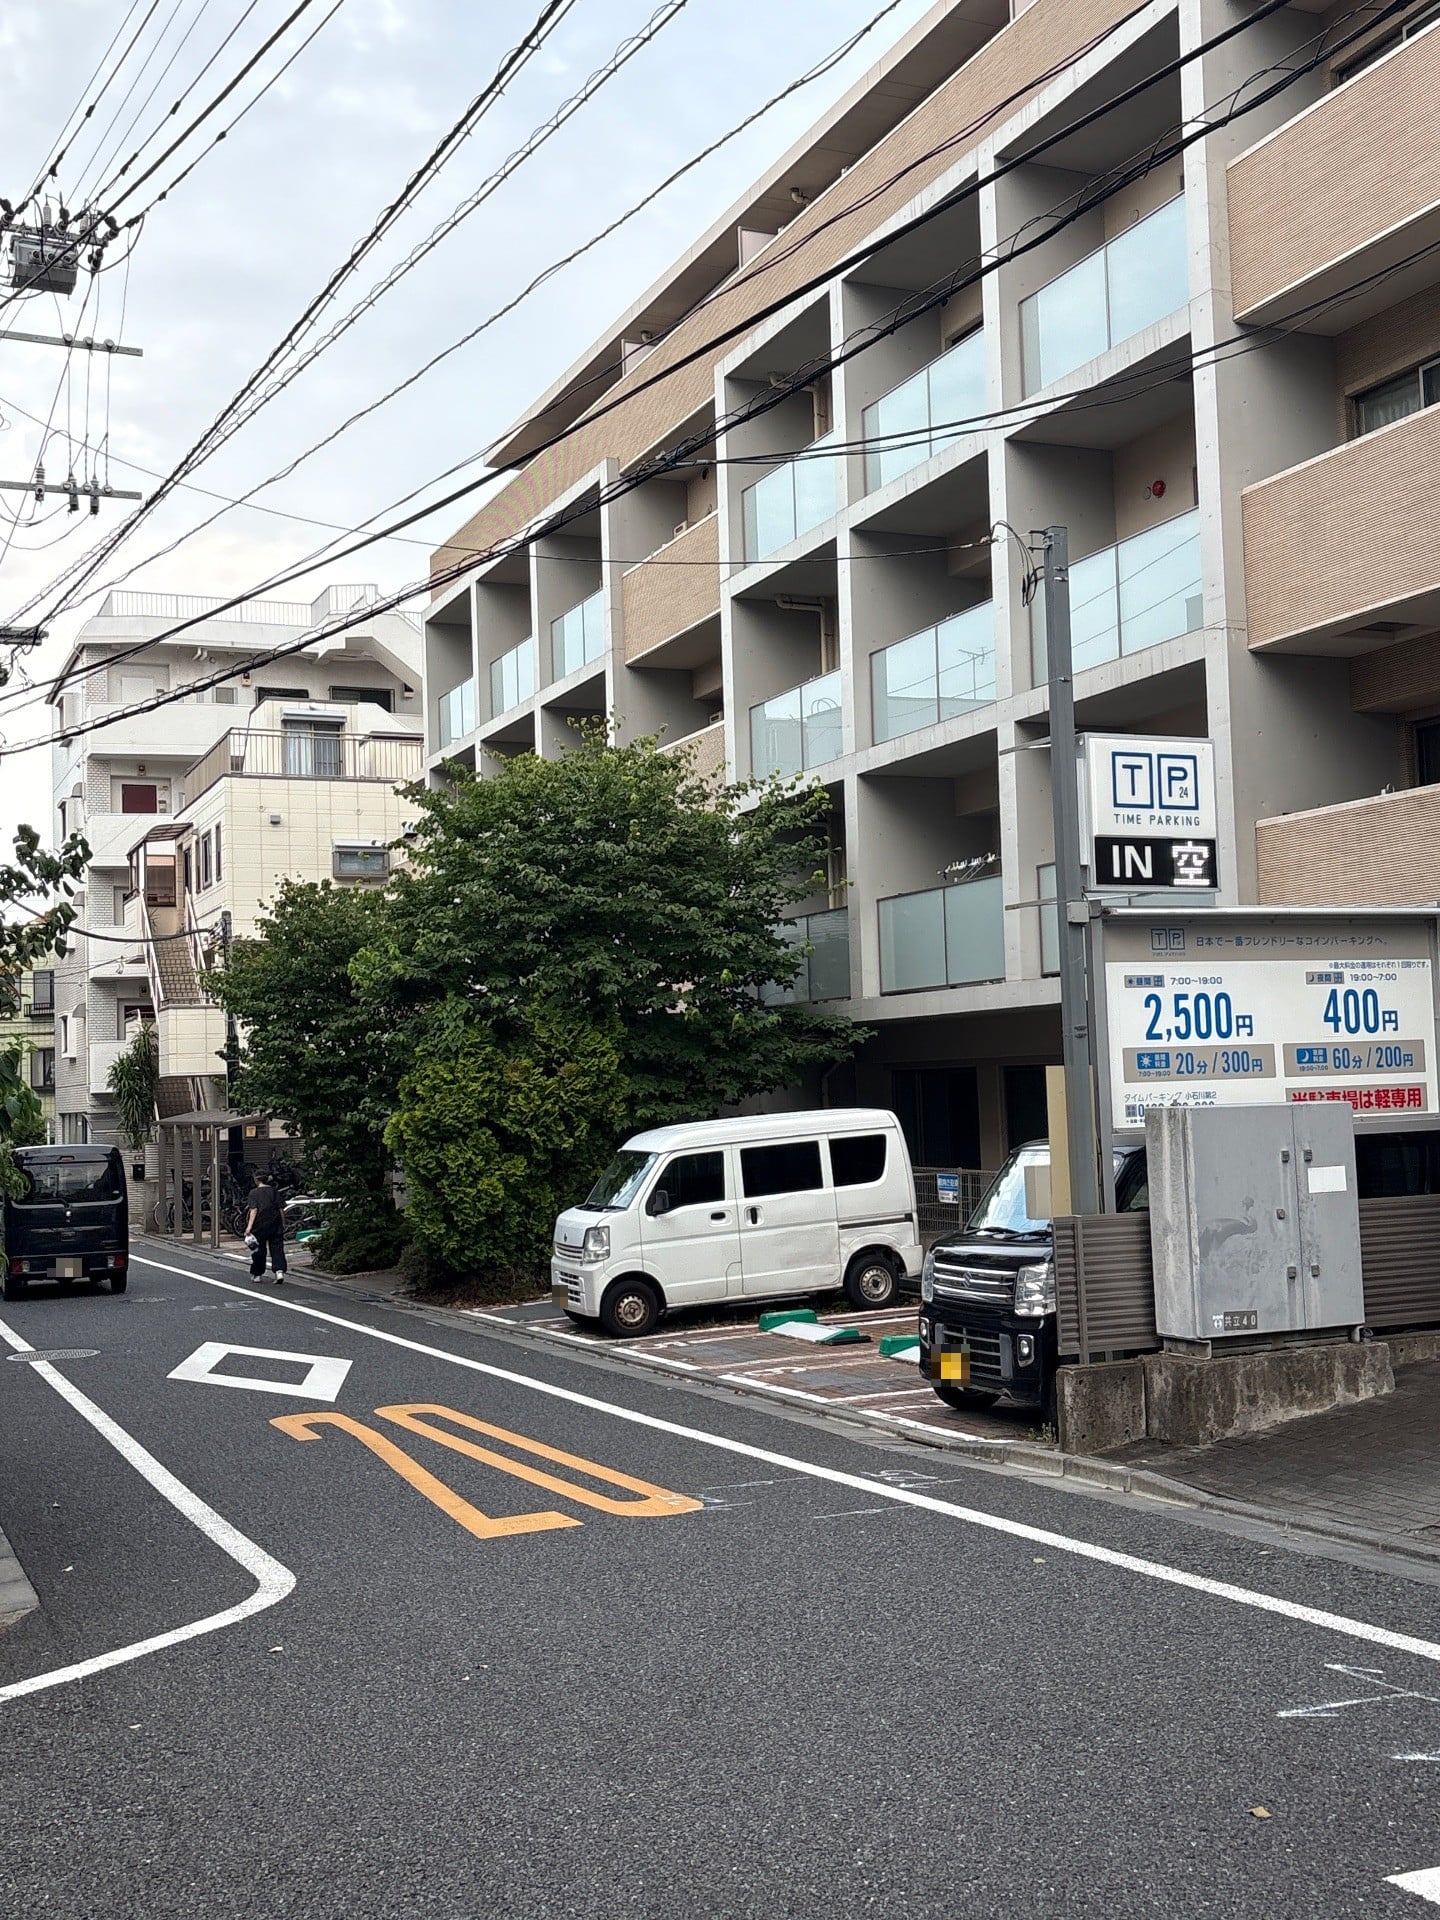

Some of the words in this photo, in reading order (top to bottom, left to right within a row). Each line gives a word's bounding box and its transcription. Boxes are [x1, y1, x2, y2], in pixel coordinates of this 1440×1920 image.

[1113, 813, 1142, 825] TIME
[1149, 814, 1201, 827] PARKING
[1111, 844, 1153, 879] IN
[1171, 840, 1211, 886] 空
[1144, 991, 1254, 1042] 2,500円
[1323, 988, 1399, 1034] 400円
[269, 1403, 705, 1540] 20
